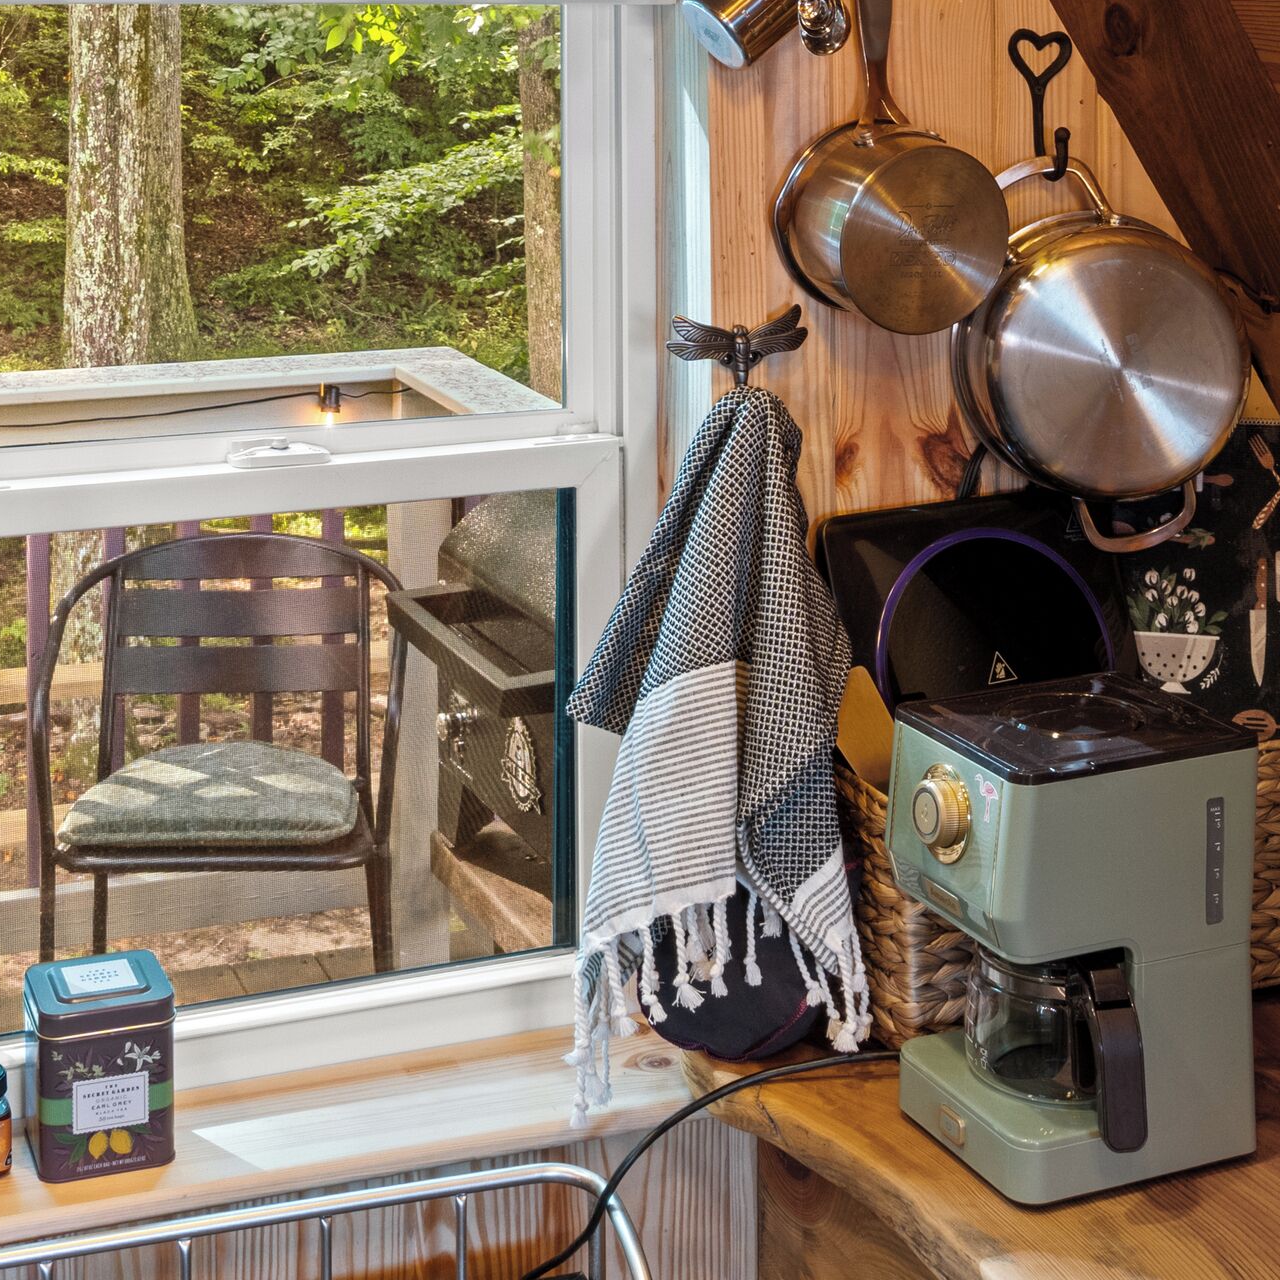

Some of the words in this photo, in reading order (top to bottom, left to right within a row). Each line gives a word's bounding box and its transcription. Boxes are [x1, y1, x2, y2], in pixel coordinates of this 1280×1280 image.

[82, 1090, 110, 1099] SECRET
[111, 1085, 140, 1095] GARDEN
[91, 1103, 111, 1111] EARL
[112, 1099, 132, 1107] GREY
